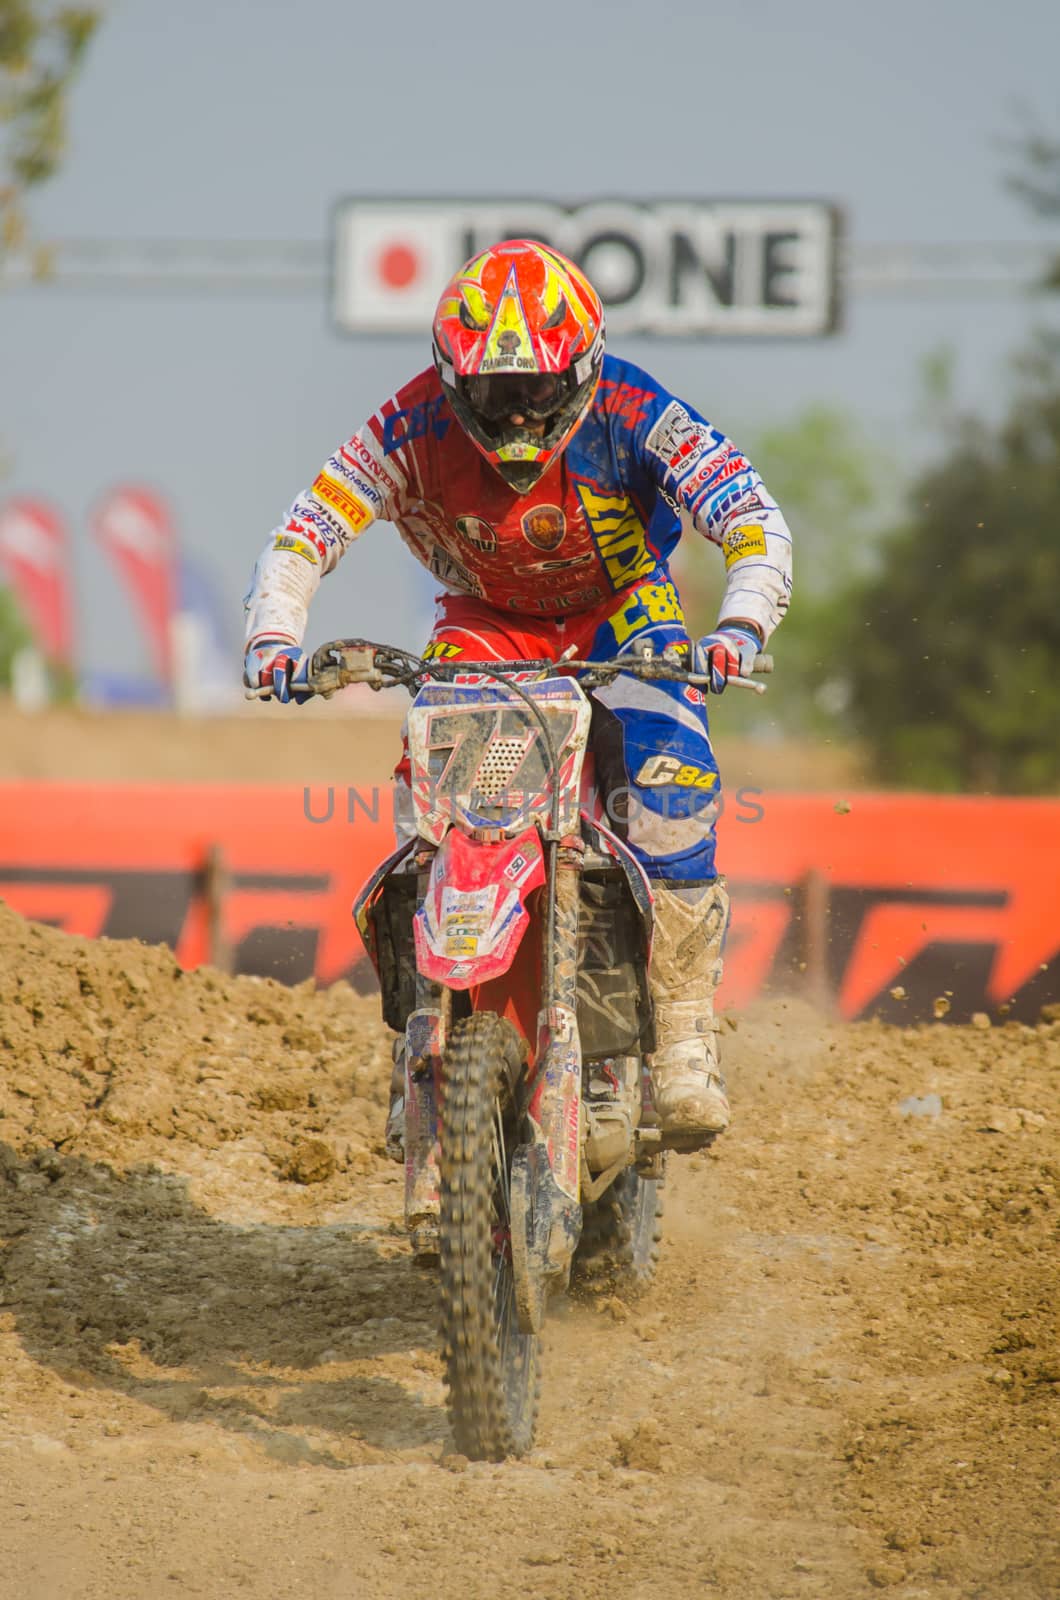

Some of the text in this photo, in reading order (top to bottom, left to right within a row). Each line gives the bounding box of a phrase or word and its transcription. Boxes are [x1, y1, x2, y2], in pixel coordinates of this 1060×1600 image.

[516, 356, 535, 369] ORO
[426, 706, 578, 799] 77
[634, 755, 720, 789] C84
